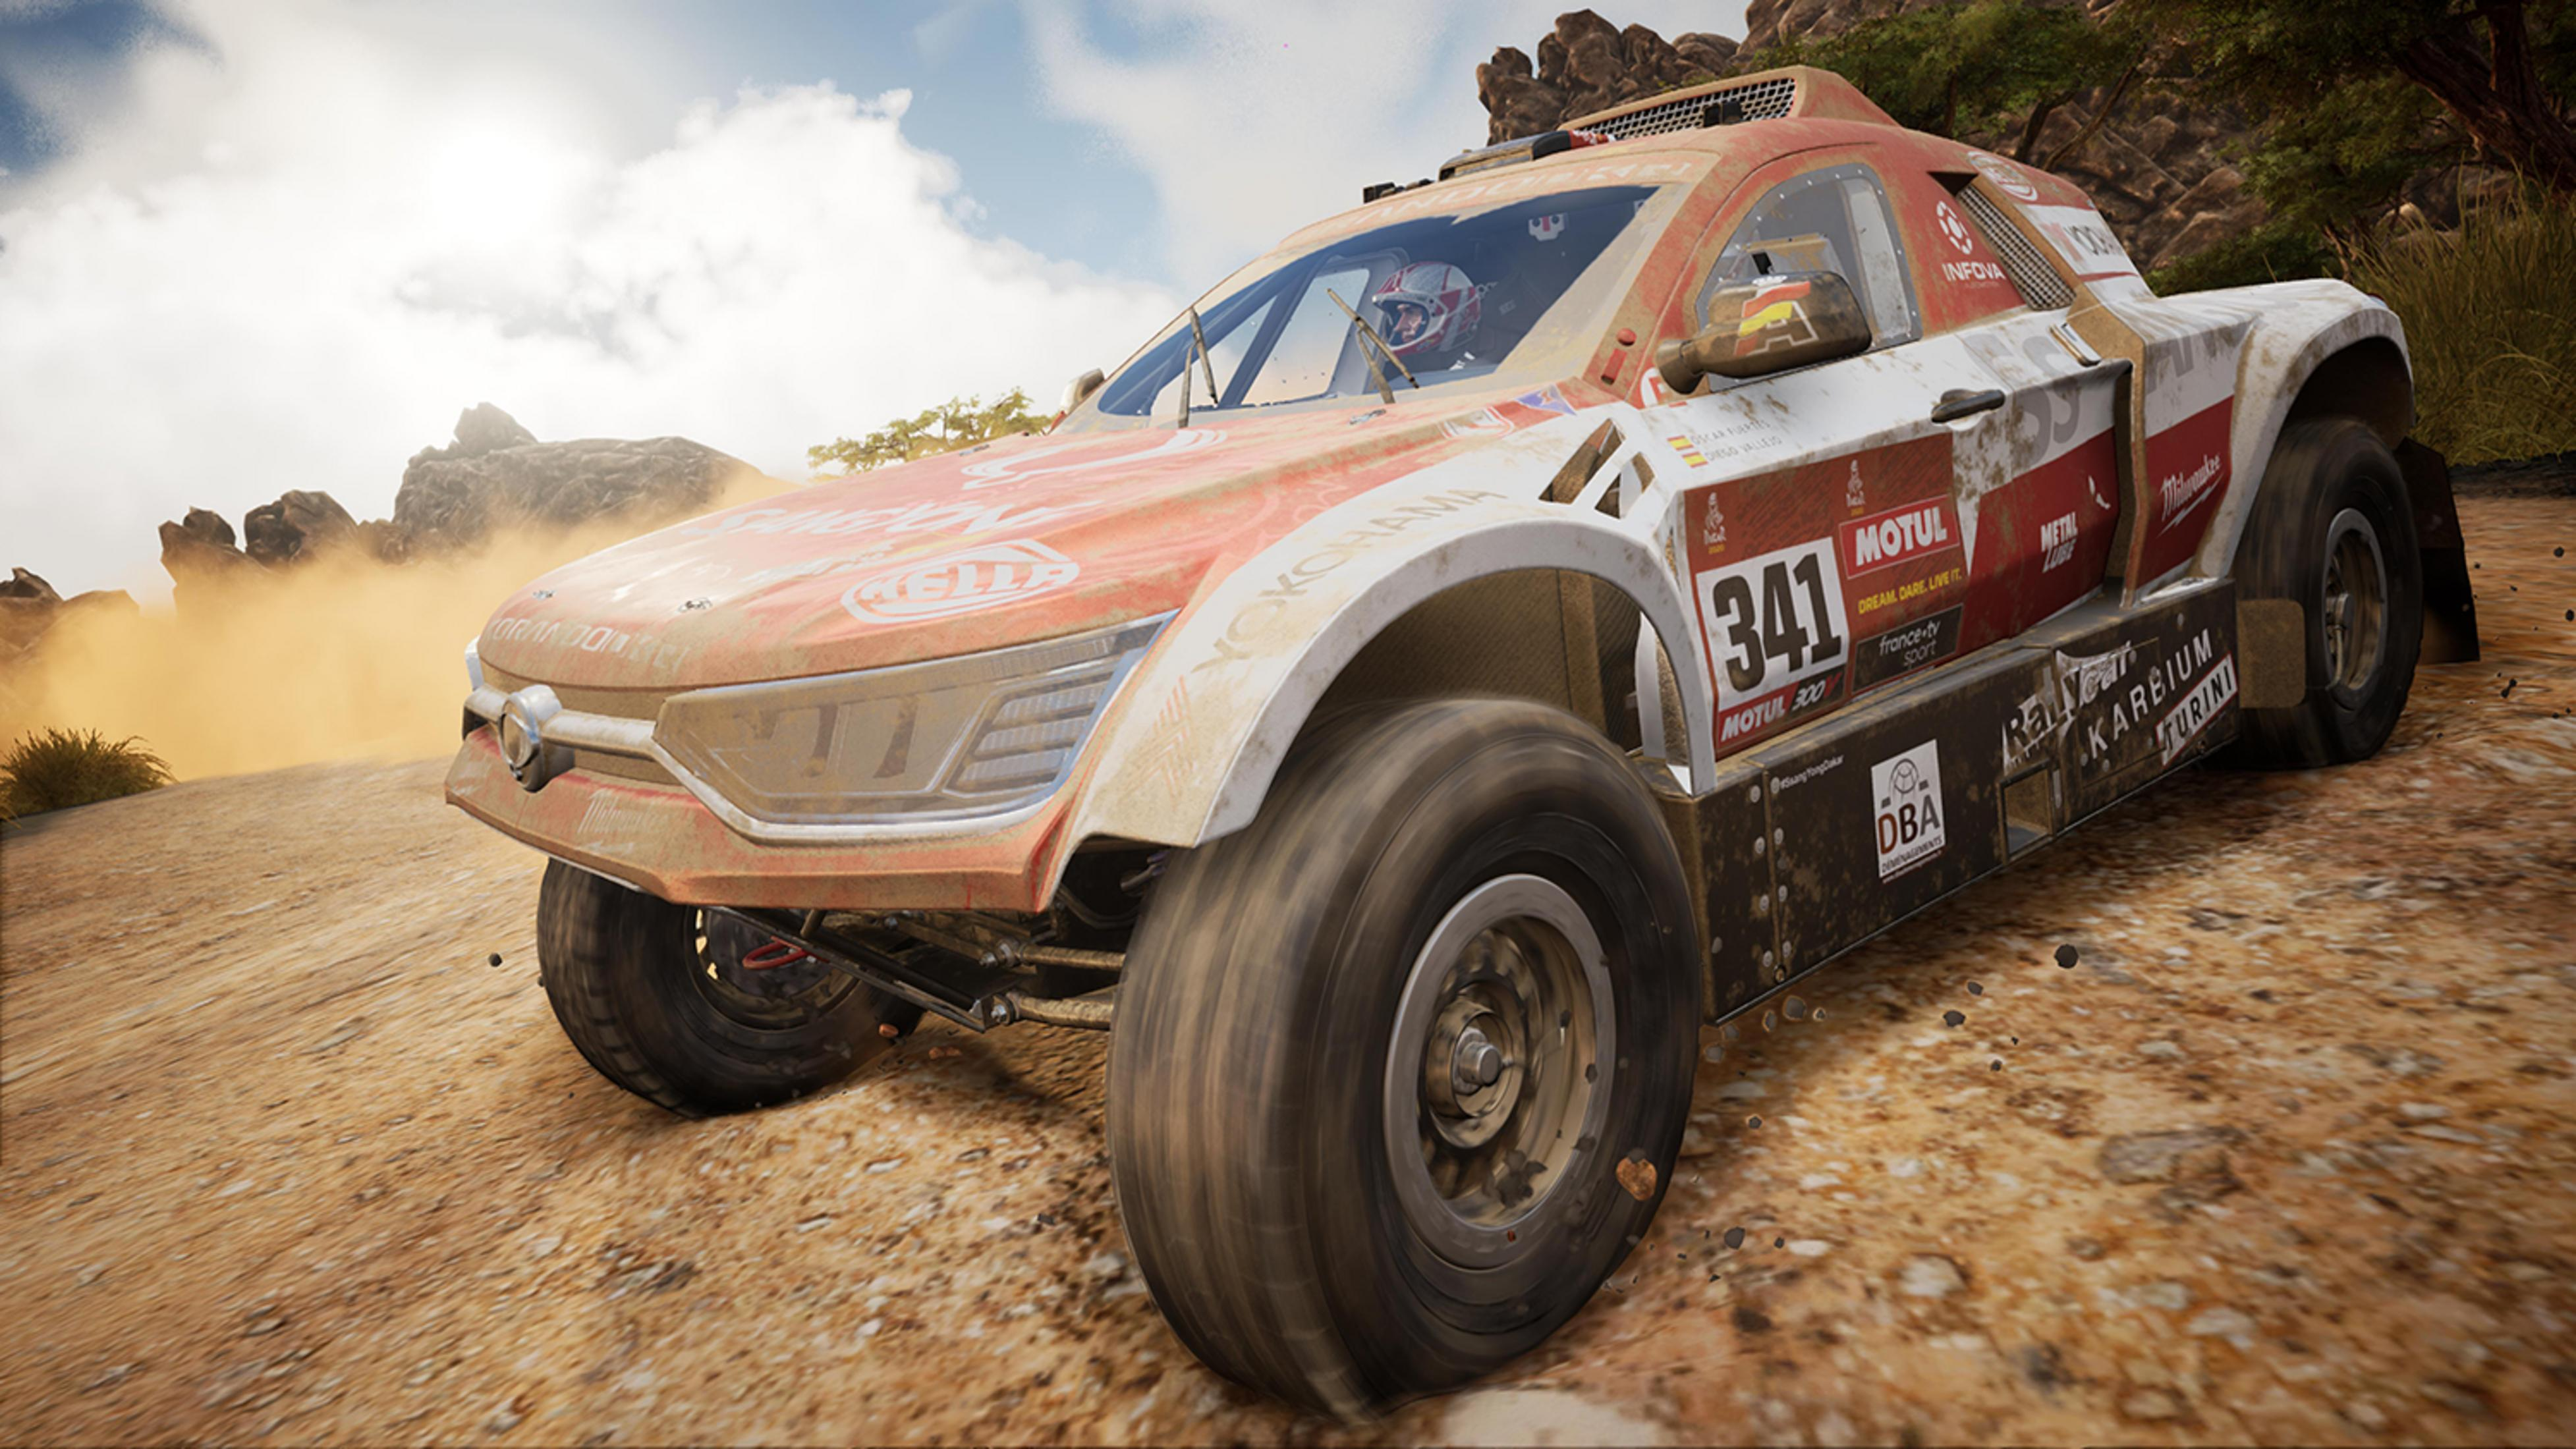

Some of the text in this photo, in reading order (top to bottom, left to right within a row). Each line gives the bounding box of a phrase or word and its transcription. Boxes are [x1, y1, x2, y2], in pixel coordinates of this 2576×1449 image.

[1941, 261, 2006, 282] INFOVA
[2159, 454, 2221, 522] Milwaukee
[1855, 506, 1948, 567] MOTUL
[2040, 511, 2079, 553] METAL
[861, 562, 1079, 601] HELLA
[1190, 489, 1508, 674] YOKOHAMA
[1857, 589, 1898, 615] DREAM.
[1898, 579, 1928, 601] DARE.
[1928, 570, 1949, 590] LIVE
[1713, 553, 1842, 692] 341
[1903, 638, 1936, 667] sport
[1720, 694, 1786, 743] MOTUL
[2087, 628, 2214, 760] KARBIUM
[2164, 665, 2232, 753] TURINI
[1877, 794, 1940, 855] DBA
